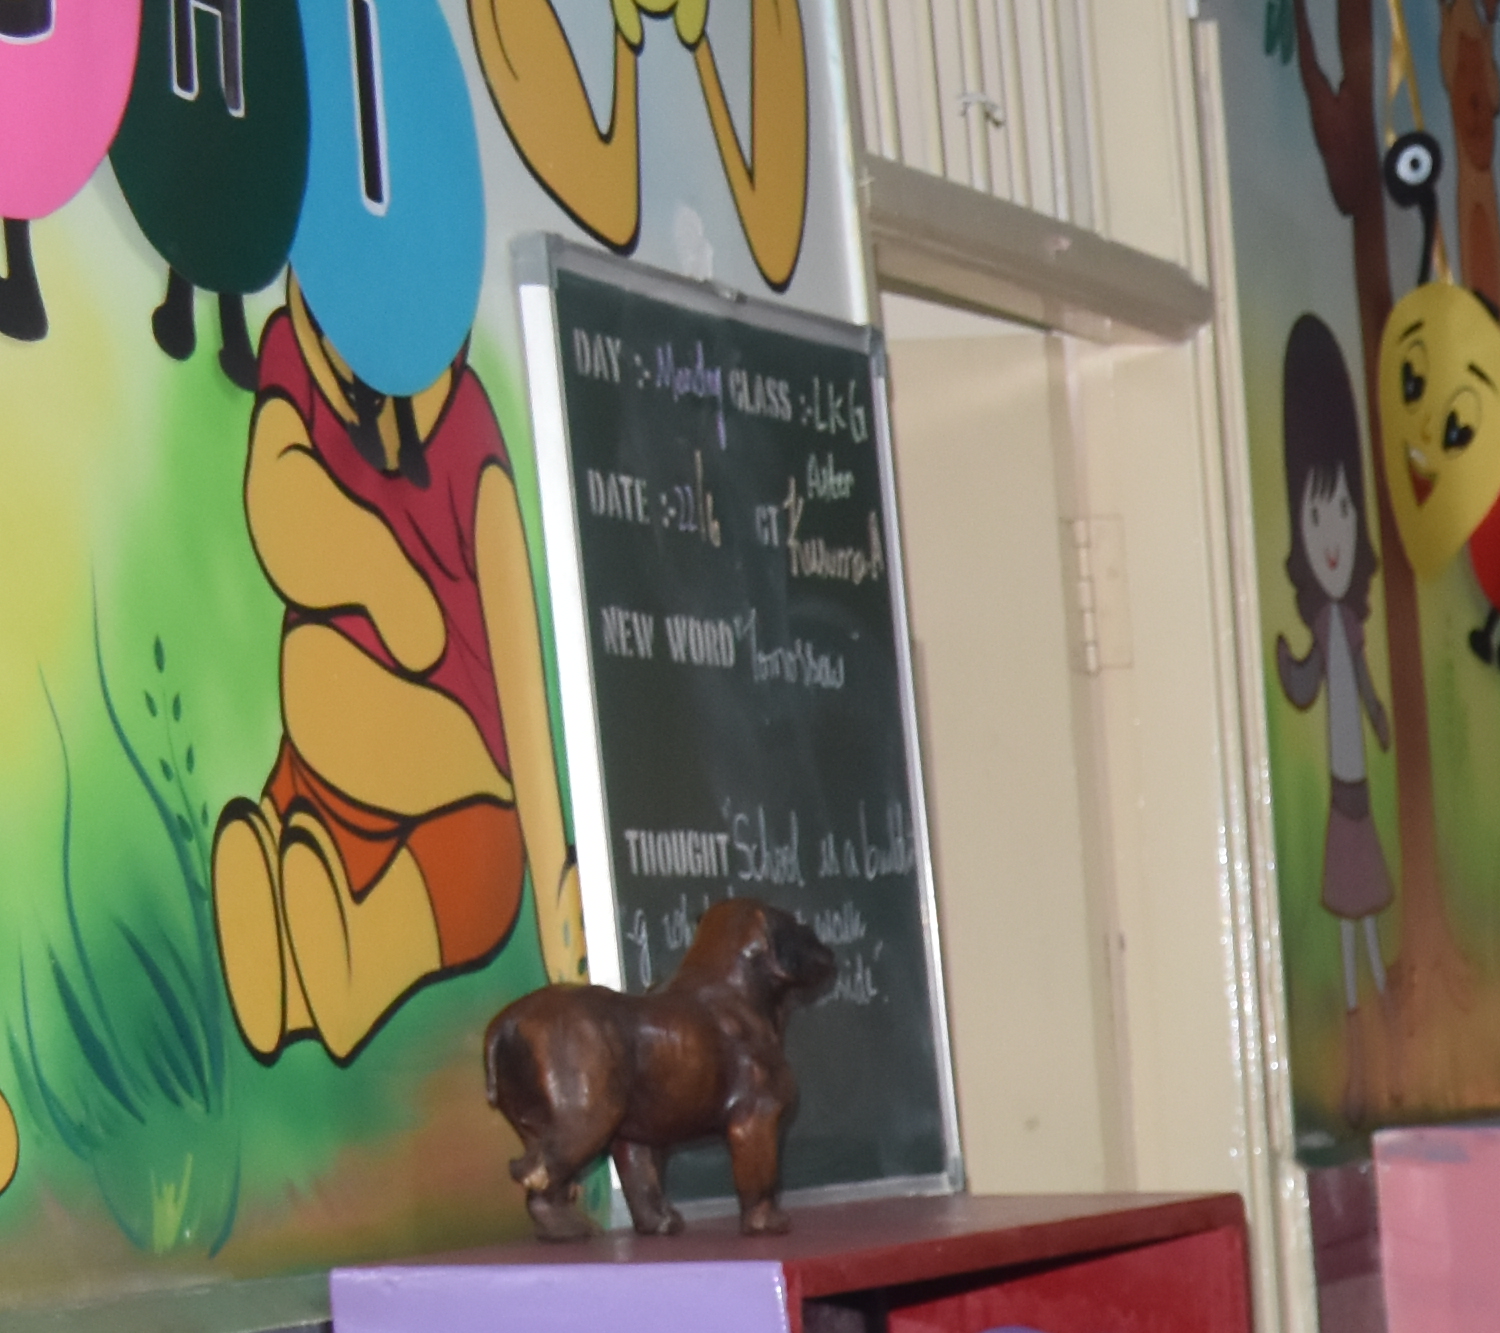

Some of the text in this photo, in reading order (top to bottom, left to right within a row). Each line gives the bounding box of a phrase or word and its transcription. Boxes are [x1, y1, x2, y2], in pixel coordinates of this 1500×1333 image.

[573, 328, 622, 383] DAY
[729, 368, 793, 422] CLASS
[588, 468, 650, 525] DATE
[754, 504, 780, 547] CT
[601, 606, 654, 660] NEW
[665, 614, 736, 668] WORD
[625, 830, 731, 878] THOUGHT
